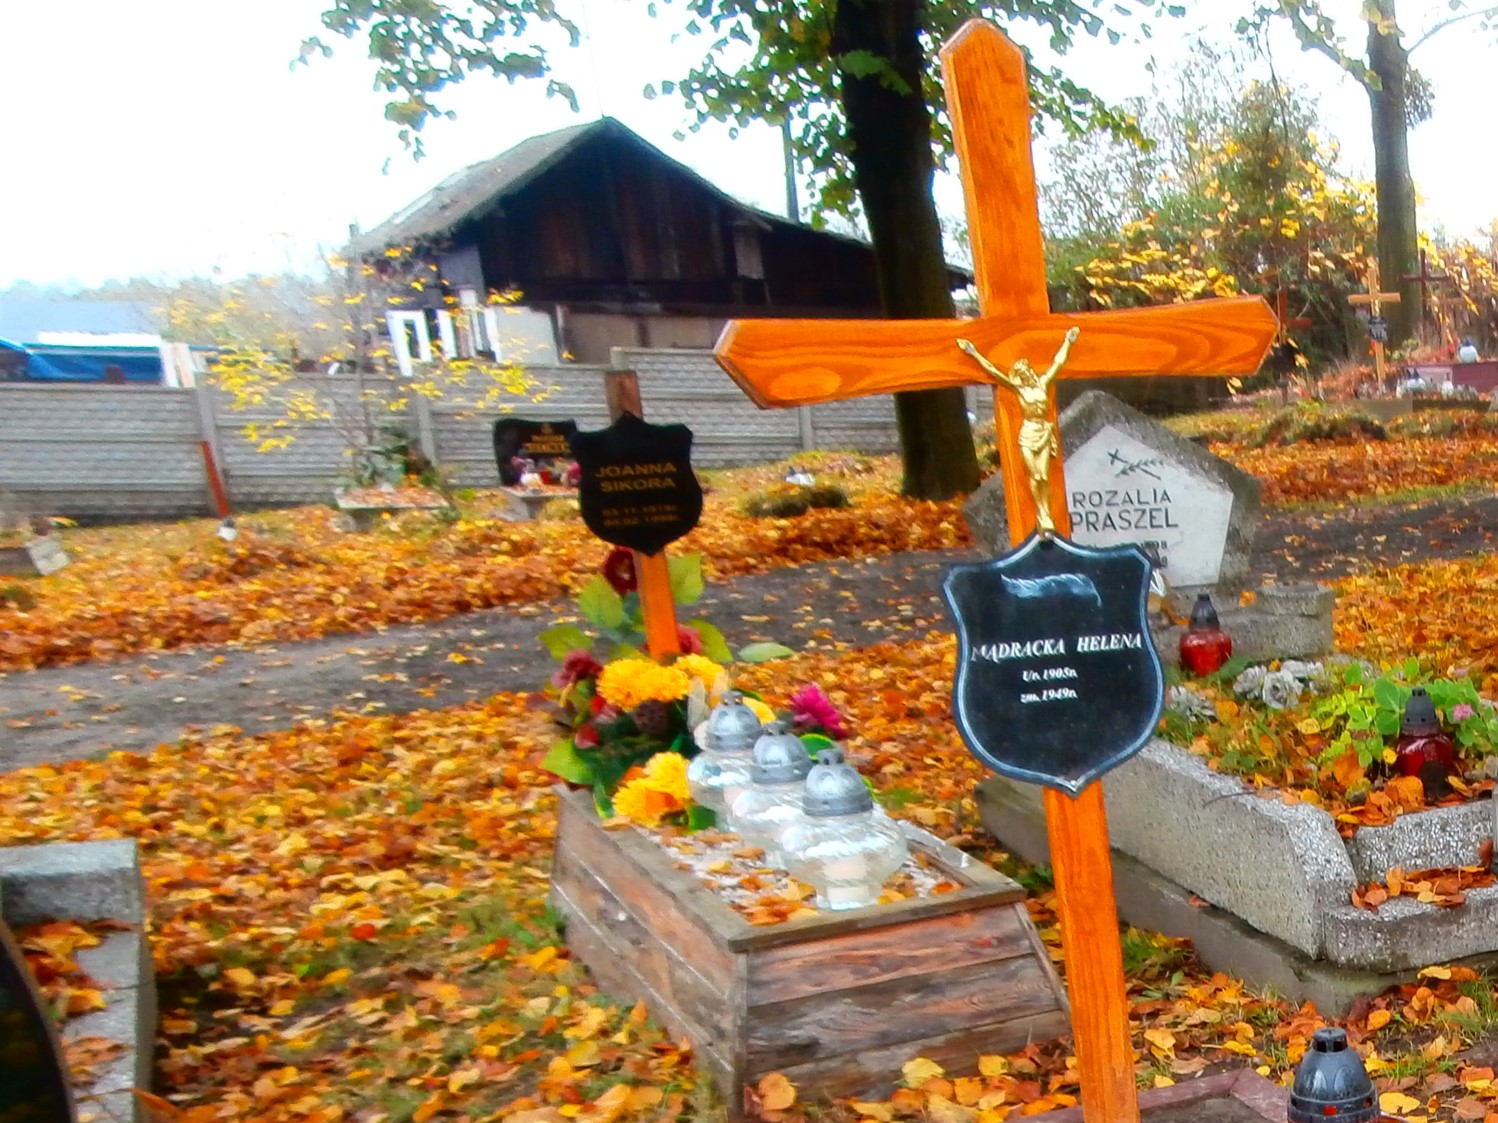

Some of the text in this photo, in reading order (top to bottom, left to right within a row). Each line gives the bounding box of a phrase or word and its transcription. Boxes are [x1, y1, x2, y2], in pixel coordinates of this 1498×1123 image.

[595, 462, 677, 478] JOANNA
[600, 478, 676, 492] SIKORA
[1072, 488, 1172, 508] ROZALIA
[1070, 507, 1179, 532] PRASZEL
[1076, 632, 1143, 653] HELENA
